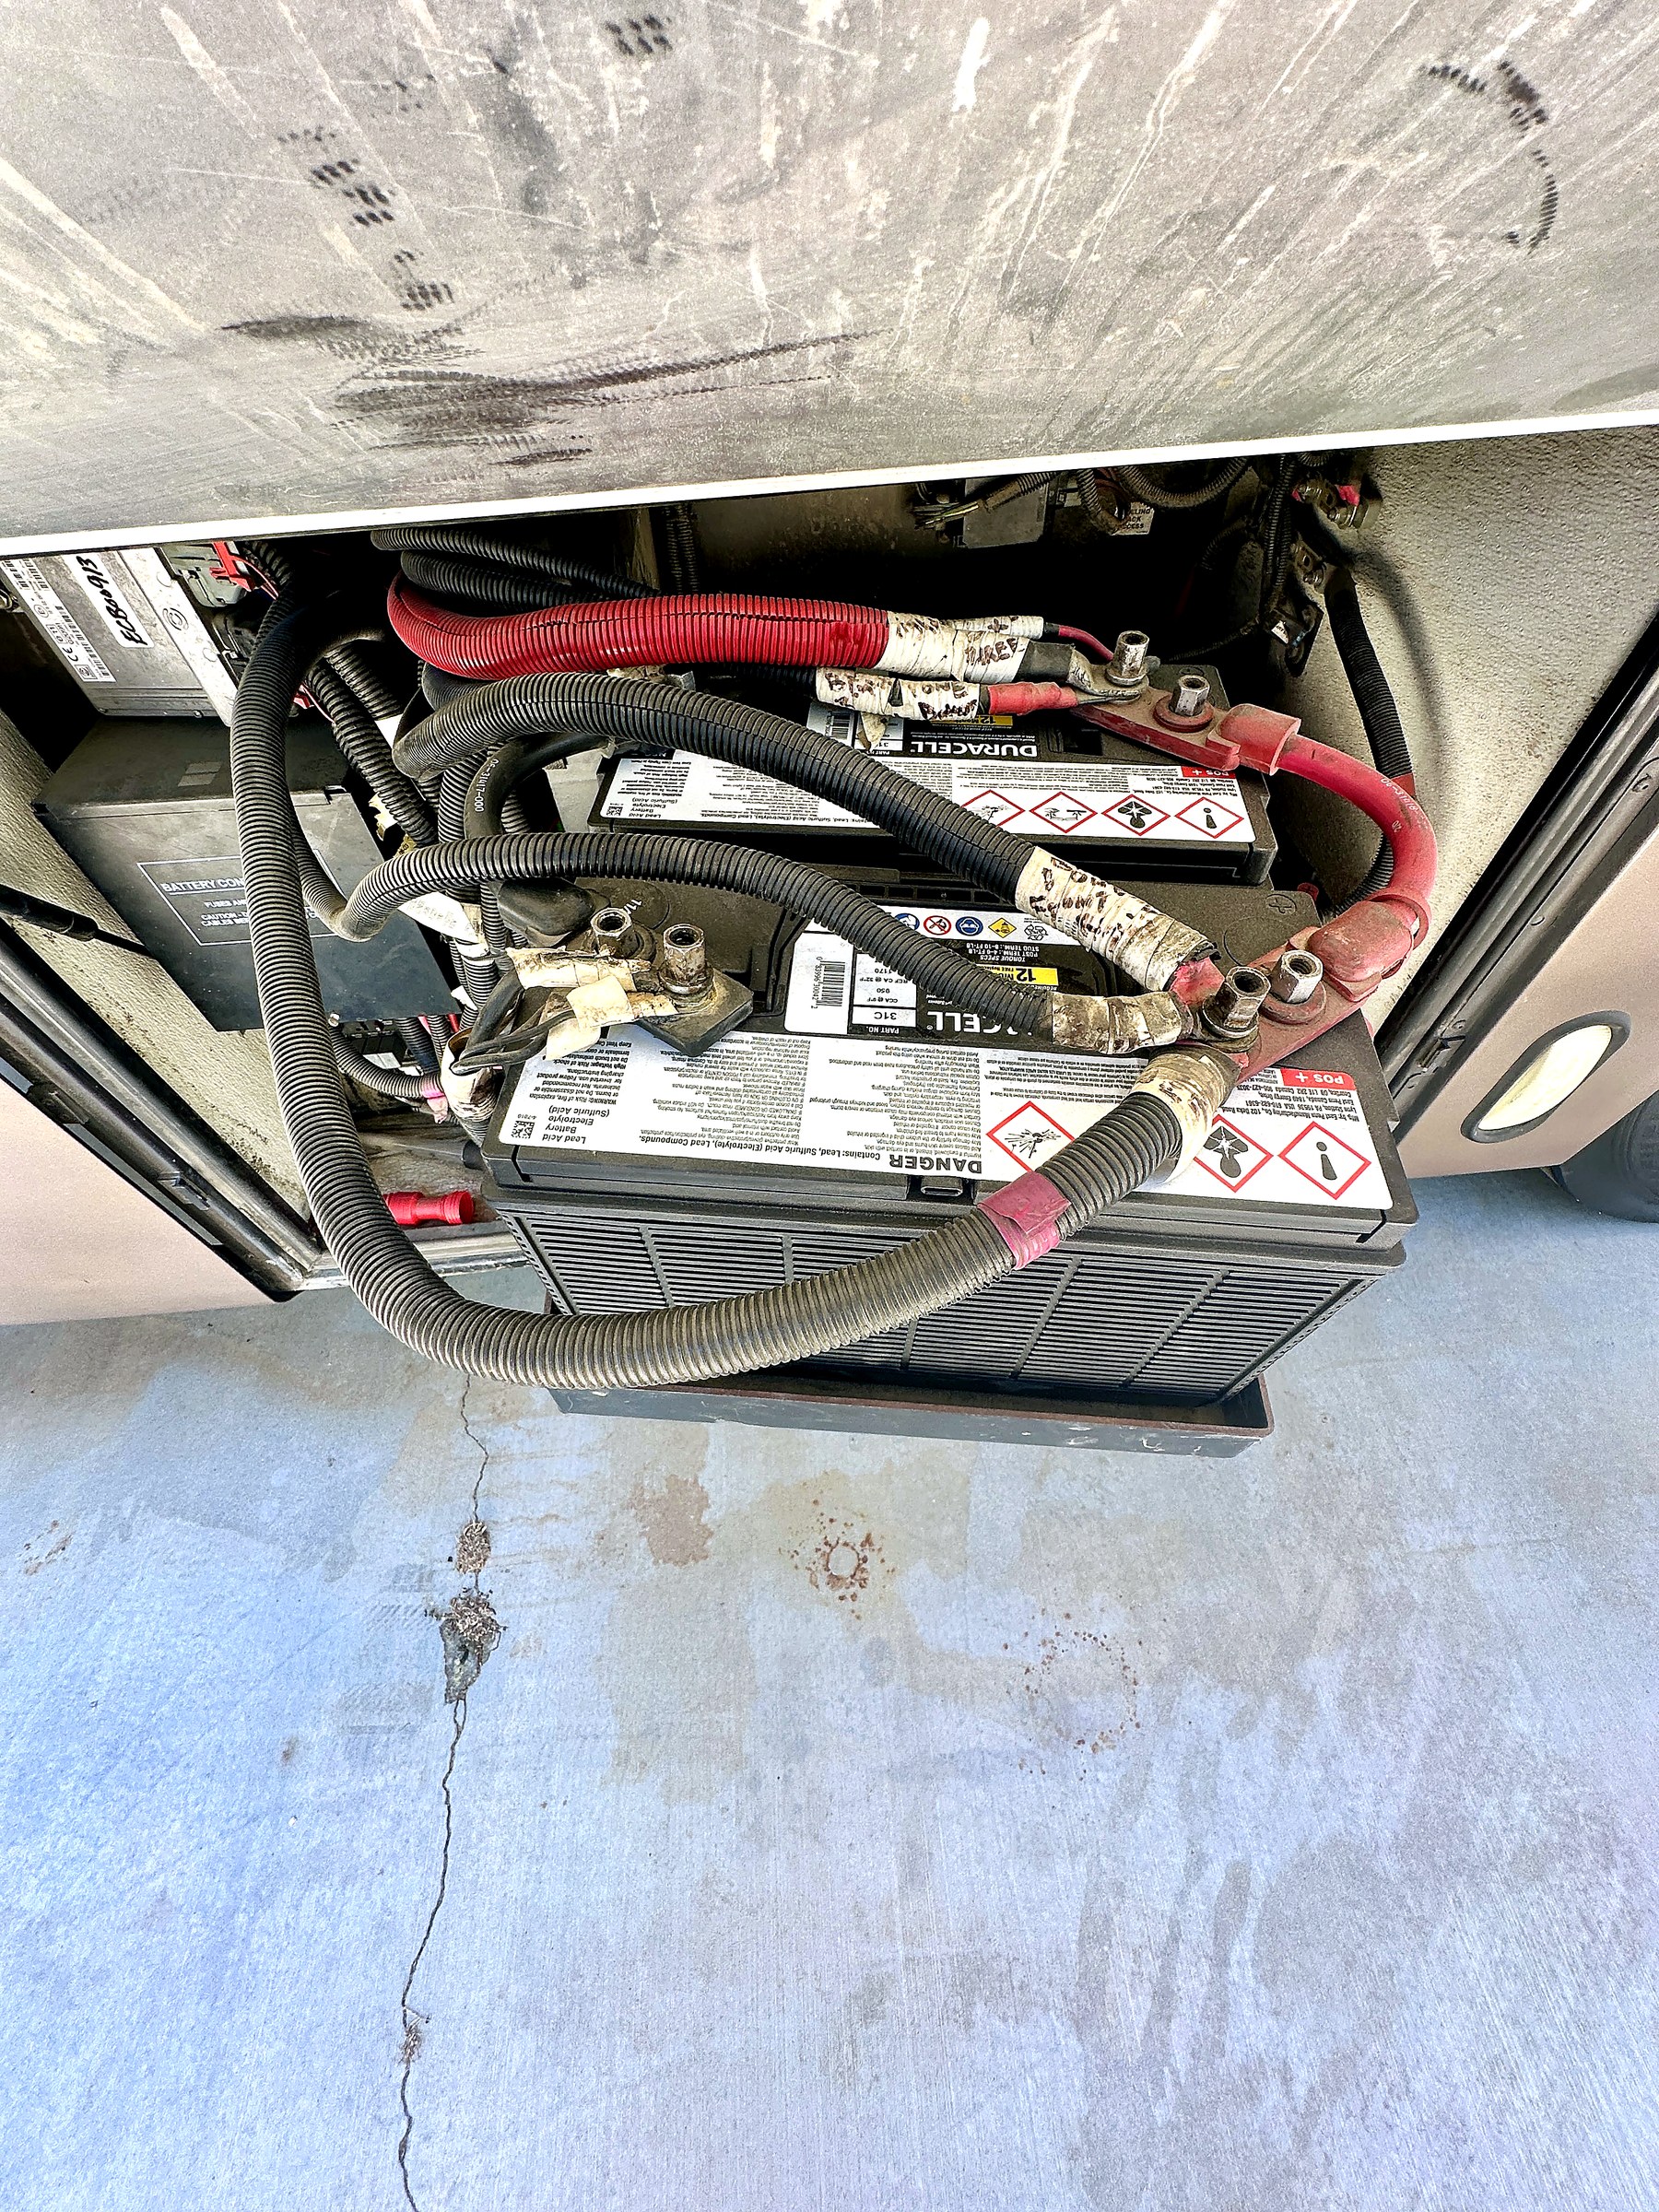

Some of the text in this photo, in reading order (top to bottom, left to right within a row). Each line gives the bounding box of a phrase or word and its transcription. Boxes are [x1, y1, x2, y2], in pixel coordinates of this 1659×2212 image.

[76, 555, 148, 646] ECB00913
[980, 715, 995, 724] 12
[920, 741, 1038, 757] DURACELL
[160, 879, 218, 892] BATTERY
[201, 912, 237, 921] CAUTION
[1016, 968, 1036, 982] 12
[874, 1011, 897, 1020] 31C
[1312, 1073, 1345, 1085] POS
[548, 1104, 609, 1118] (Sulfuric Acid)
[547, 1113, 594, 1126] Electrolyte
[546, 1123, 577, 1134] Battery
[542, 1133, 586, 1144] Lead Acid
[639, 1133, 880, 1161] Contains: Lead, Sulfuric Acid (Electrolyte), Lead Compounds.
[888, 1155, 982, 1174] DANGER
